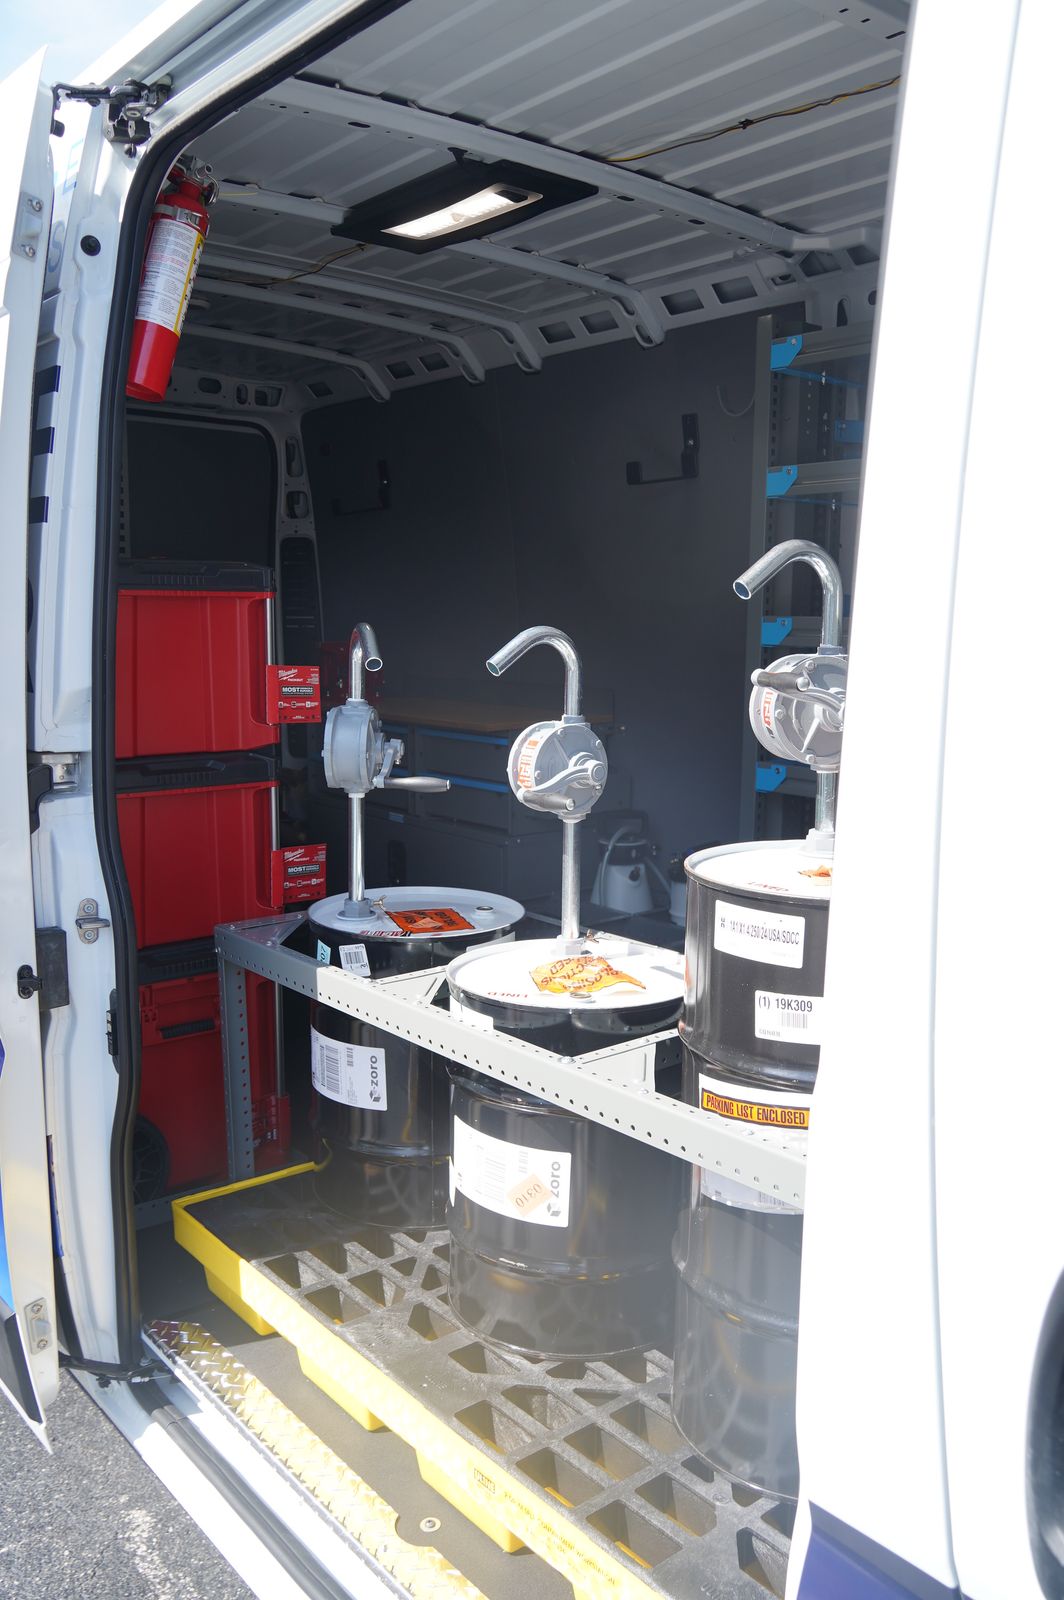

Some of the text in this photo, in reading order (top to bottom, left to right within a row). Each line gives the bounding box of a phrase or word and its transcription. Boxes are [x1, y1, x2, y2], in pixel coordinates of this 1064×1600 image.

[758, 995, 813, 1013] (1) 19K309
[369, 1054, 379, 1087] zoro
[705, 1094, 806, 1125] PACKING LIST ENCLOSED
